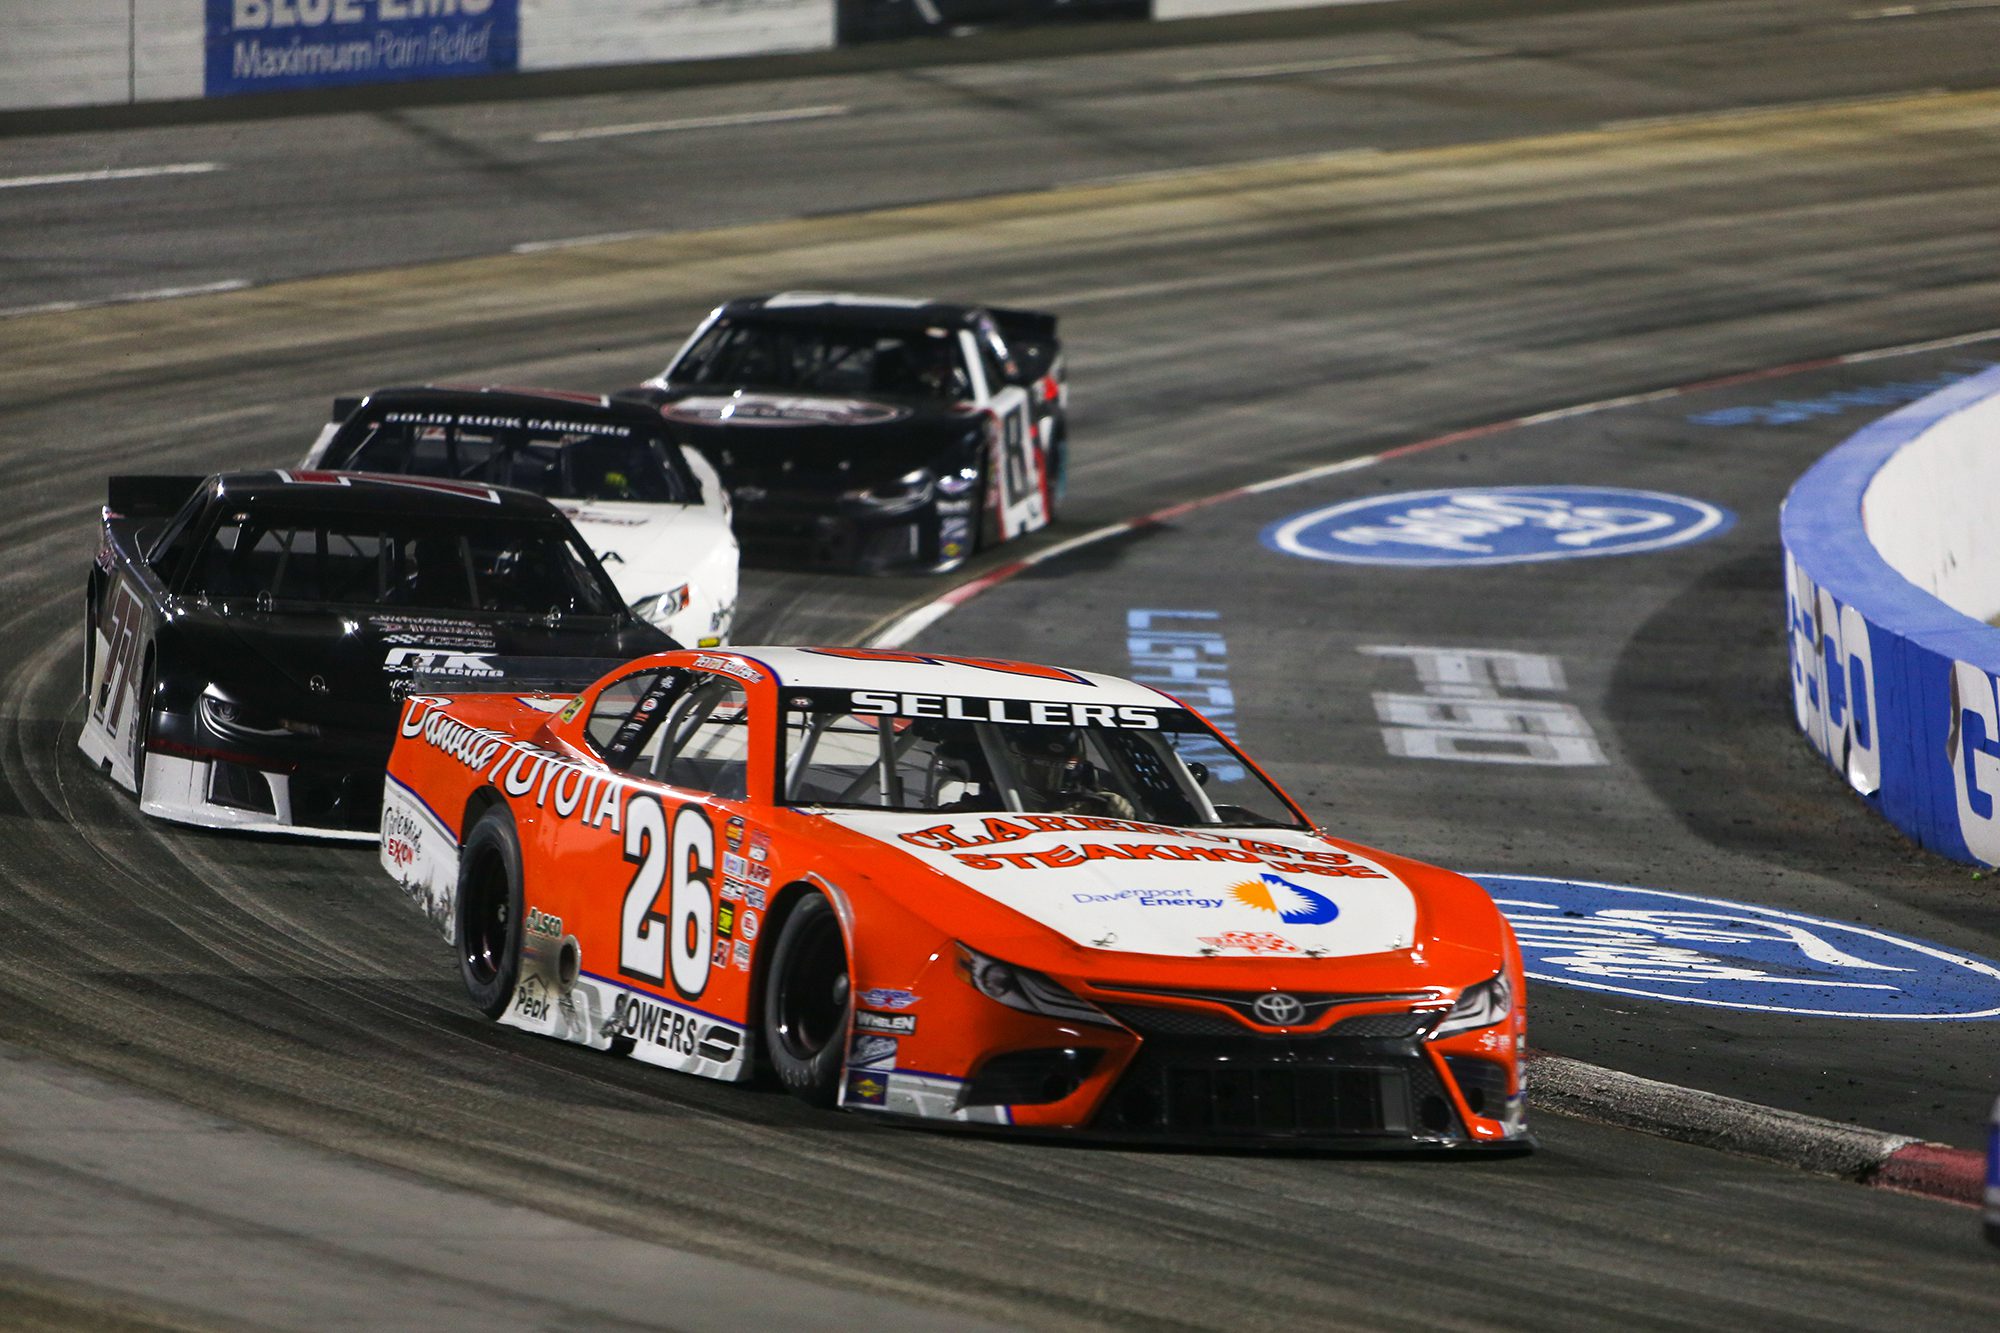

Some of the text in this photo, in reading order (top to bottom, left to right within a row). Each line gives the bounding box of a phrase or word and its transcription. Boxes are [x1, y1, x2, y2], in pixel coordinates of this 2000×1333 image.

[233, 20, 495, 78] Maximum Pain Relief
[386, 412, 631, 437] SOLID ROCK CARRIERS
[851, 690, 1160, 730] SELLERS
[1127, 610, 1246, 784] LIGHTIN
[401, 696, 624, 833] Danville TOYOTA
[388, 838, 413, 867] EXXON
[952, 843, 1389, 880] STEAKHOUSE
[618, 791, 714, 1001] 26
[1073, 886, 1195, 906] Davenport
[1140, 895, 1225, 910] Energy
